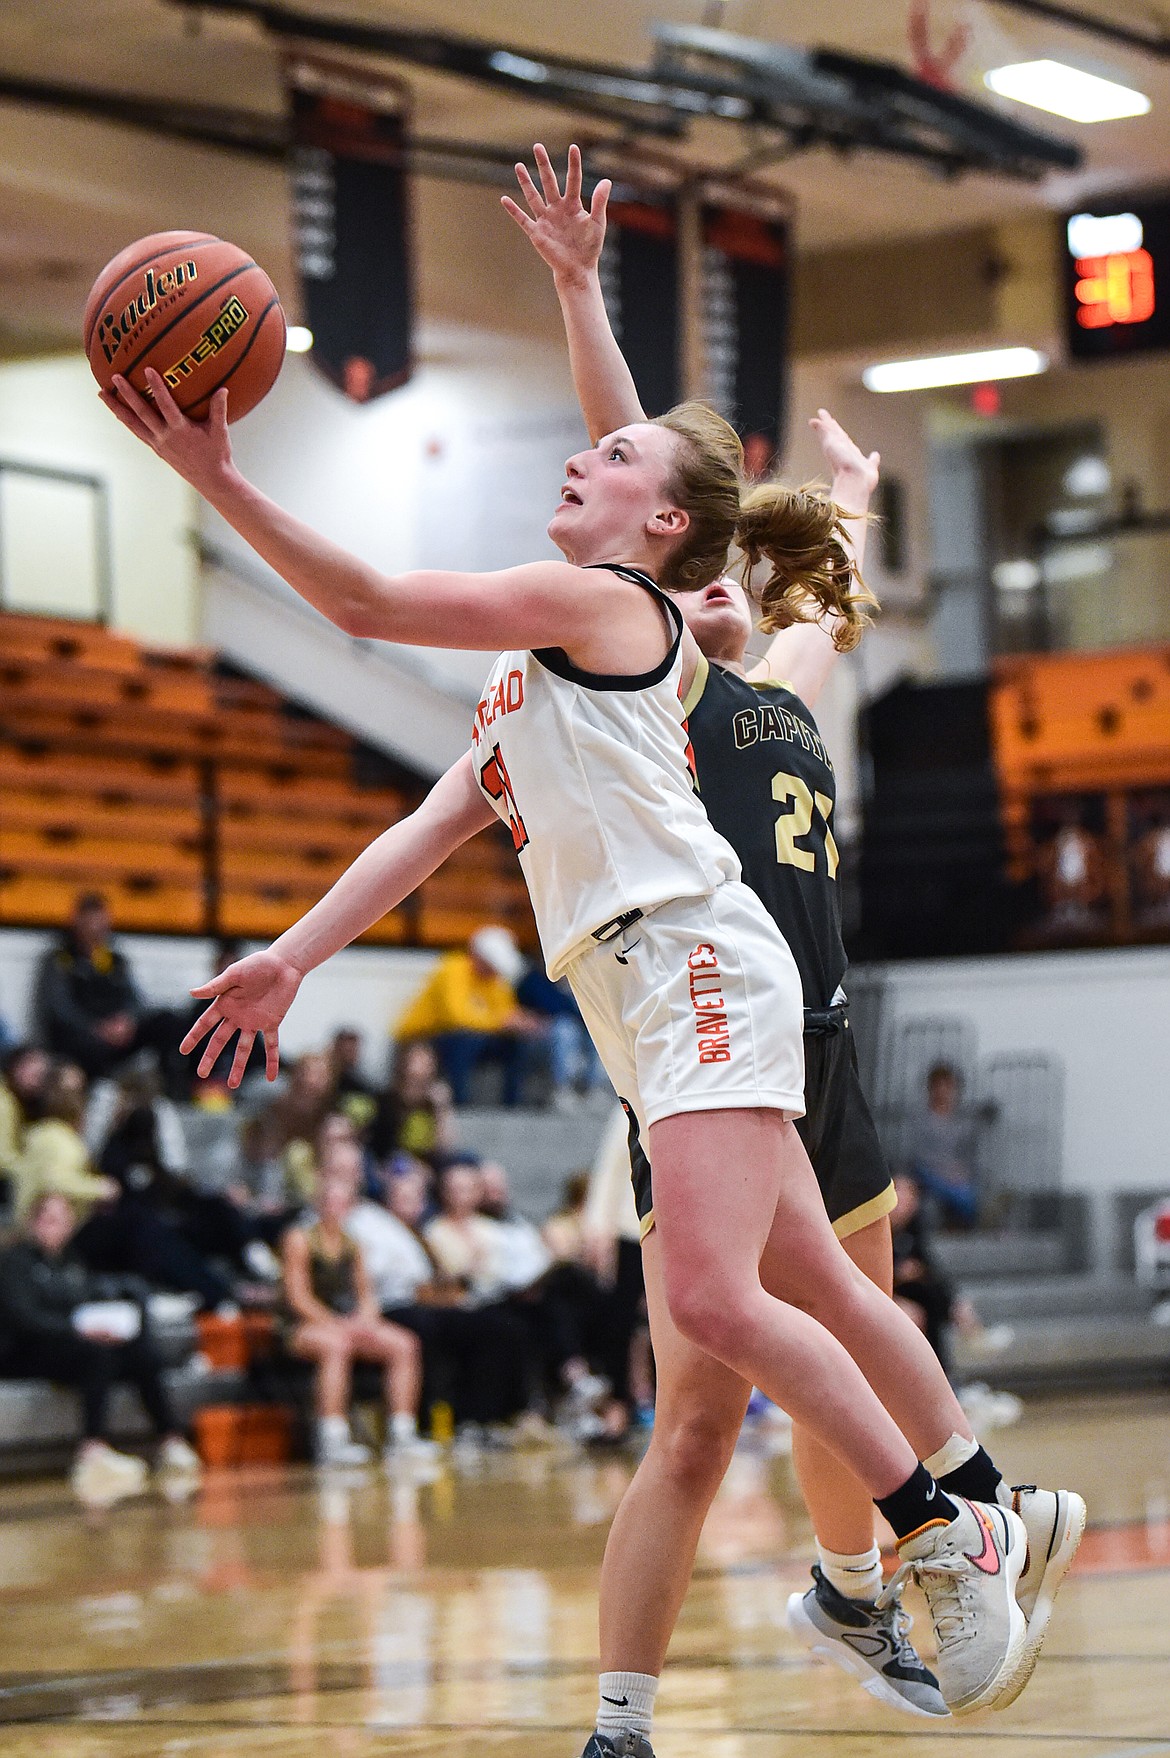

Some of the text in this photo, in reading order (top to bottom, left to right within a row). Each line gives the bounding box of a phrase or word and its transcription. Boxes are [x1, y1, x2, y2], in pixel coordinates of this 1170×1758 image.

[98, 260, 198, 364] Baden
[210, 302, 246, 346] PRO
[772, 771, 840, 881] 21
[688, 943, 732, 1064] BRAVETTES
